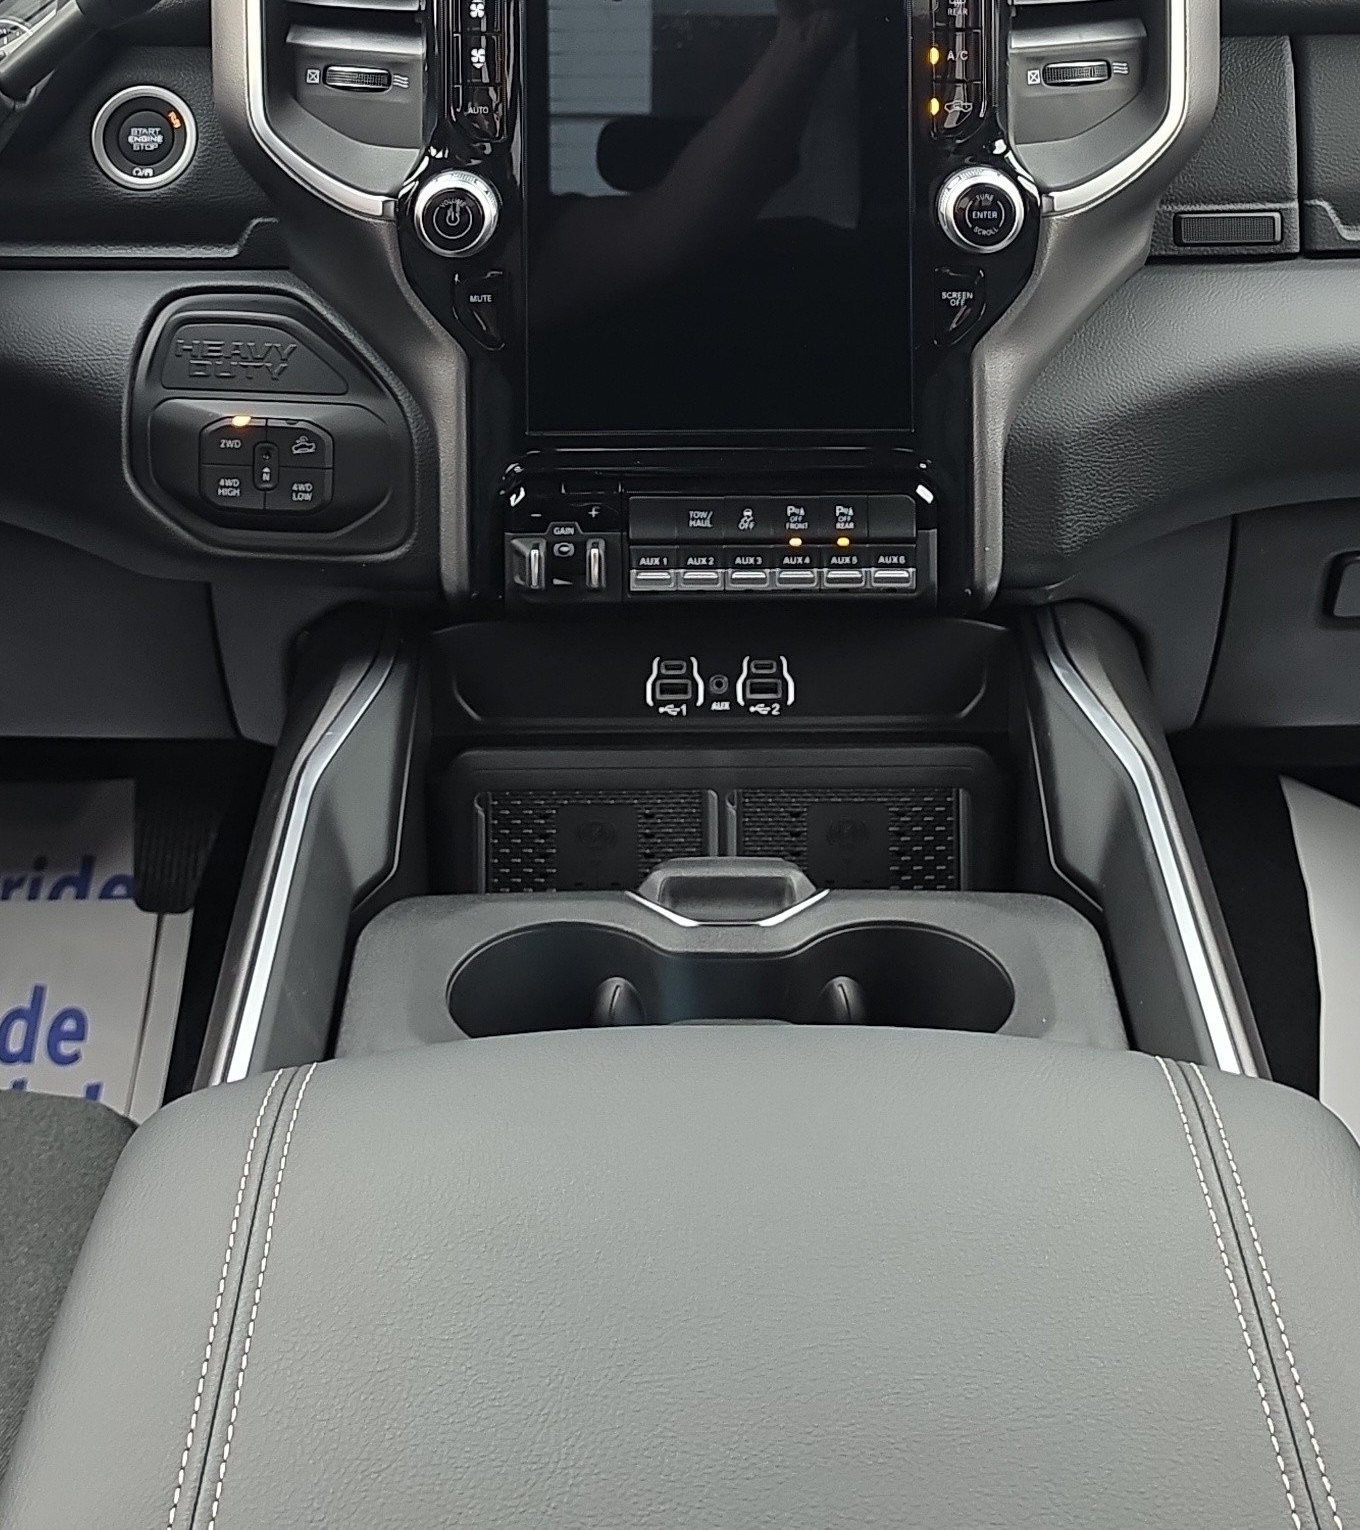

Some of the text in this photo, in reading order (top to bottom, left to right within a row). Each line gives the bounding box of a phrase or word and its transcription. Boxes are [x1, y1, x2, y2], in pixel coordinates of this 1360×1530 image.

[947, 8, 968, 16] REAR
[946, 50, 969, 62] A/C
[468, 105, 489, 114] AUTO
[130, 127, 161, 136] START
[127, 135, 164, 144] ENGINE
[133, 143, 159, 151] STOP
[972, 210, 998, 219] ENTER
[974, 226, 999, 237] SCROLL
[469, 293, 492, 303] MUTE
[941, 291, 973, 300] SCREEN
[949, 299, 966, 307] OFF
[175, 339, 297, 361] HEAVY
[189, 359, 288, 381] DUTY
[220, 438, 242, 449] 2WD
[262, 472, 270, 482] N
[218, 477, 240, 488] 4WD
[217, 487, 240, 497] HIGH
[291, 482, 313, 493] 4WD
[291, 492, 313, 502] LOW
[689, 510, 714, 520] TOW/
[689, 519, 713, 528] HAUL
[738, 522, 756, 530] OFF
[785, 522, 808, 530] FRONT
[835, 522, 855, 530] REAR
[553, 526, 575, 536] GAIN
[640, 557, 668, 565] AUX 1
[687, 557, 715, 565] AUX 2
[735, 556, 763, 564] AUX 3
[783, 556, 811, 564] AUX 4
[830, 556, 850, 564] AUX
[878, 555, 906, 563] AUX 6
[680, 703, 687, 716] 1
[710, 701, 731, 711] AUX
[771, 703, 780, 715] 2
